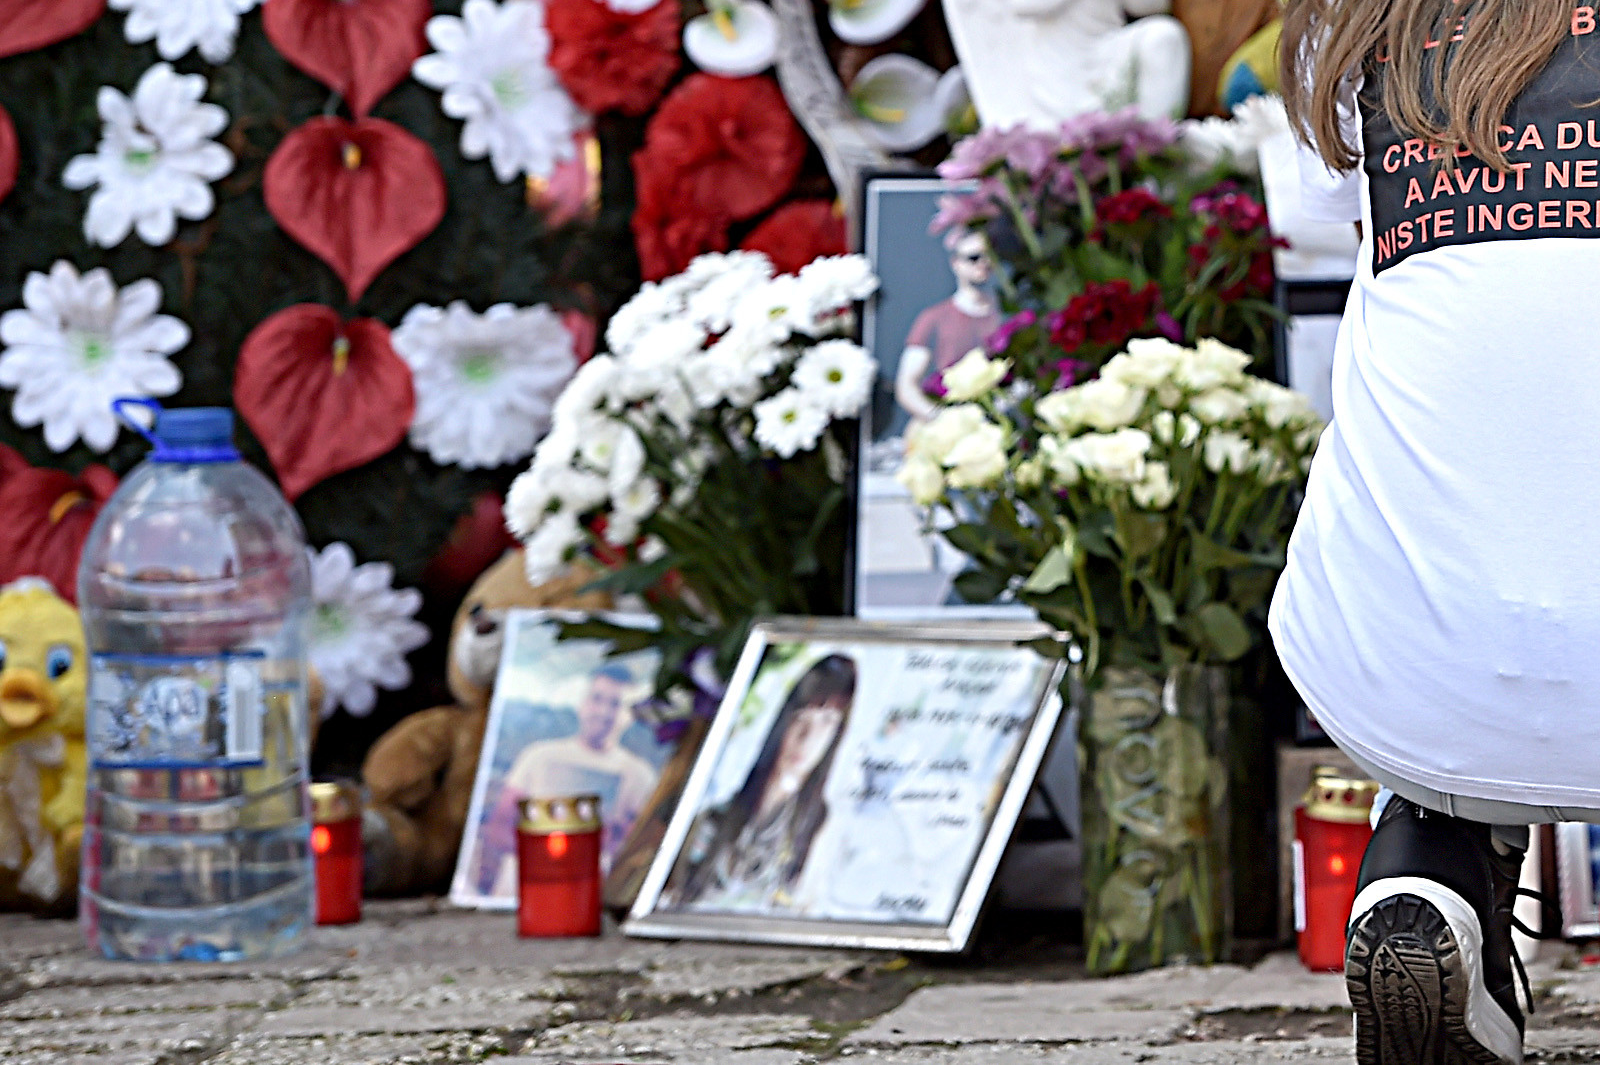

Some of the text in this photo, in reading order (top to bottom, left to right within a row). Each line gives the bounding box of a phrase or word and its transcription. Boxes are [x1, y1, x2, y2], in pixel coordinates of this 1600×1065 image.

[1497, 123, 1546, 153] CA
[1403, 177, 1426, 209] A
[1430, 162, 1532, 200] AVUT
[1376, 208, 1455, 264] NISTE
